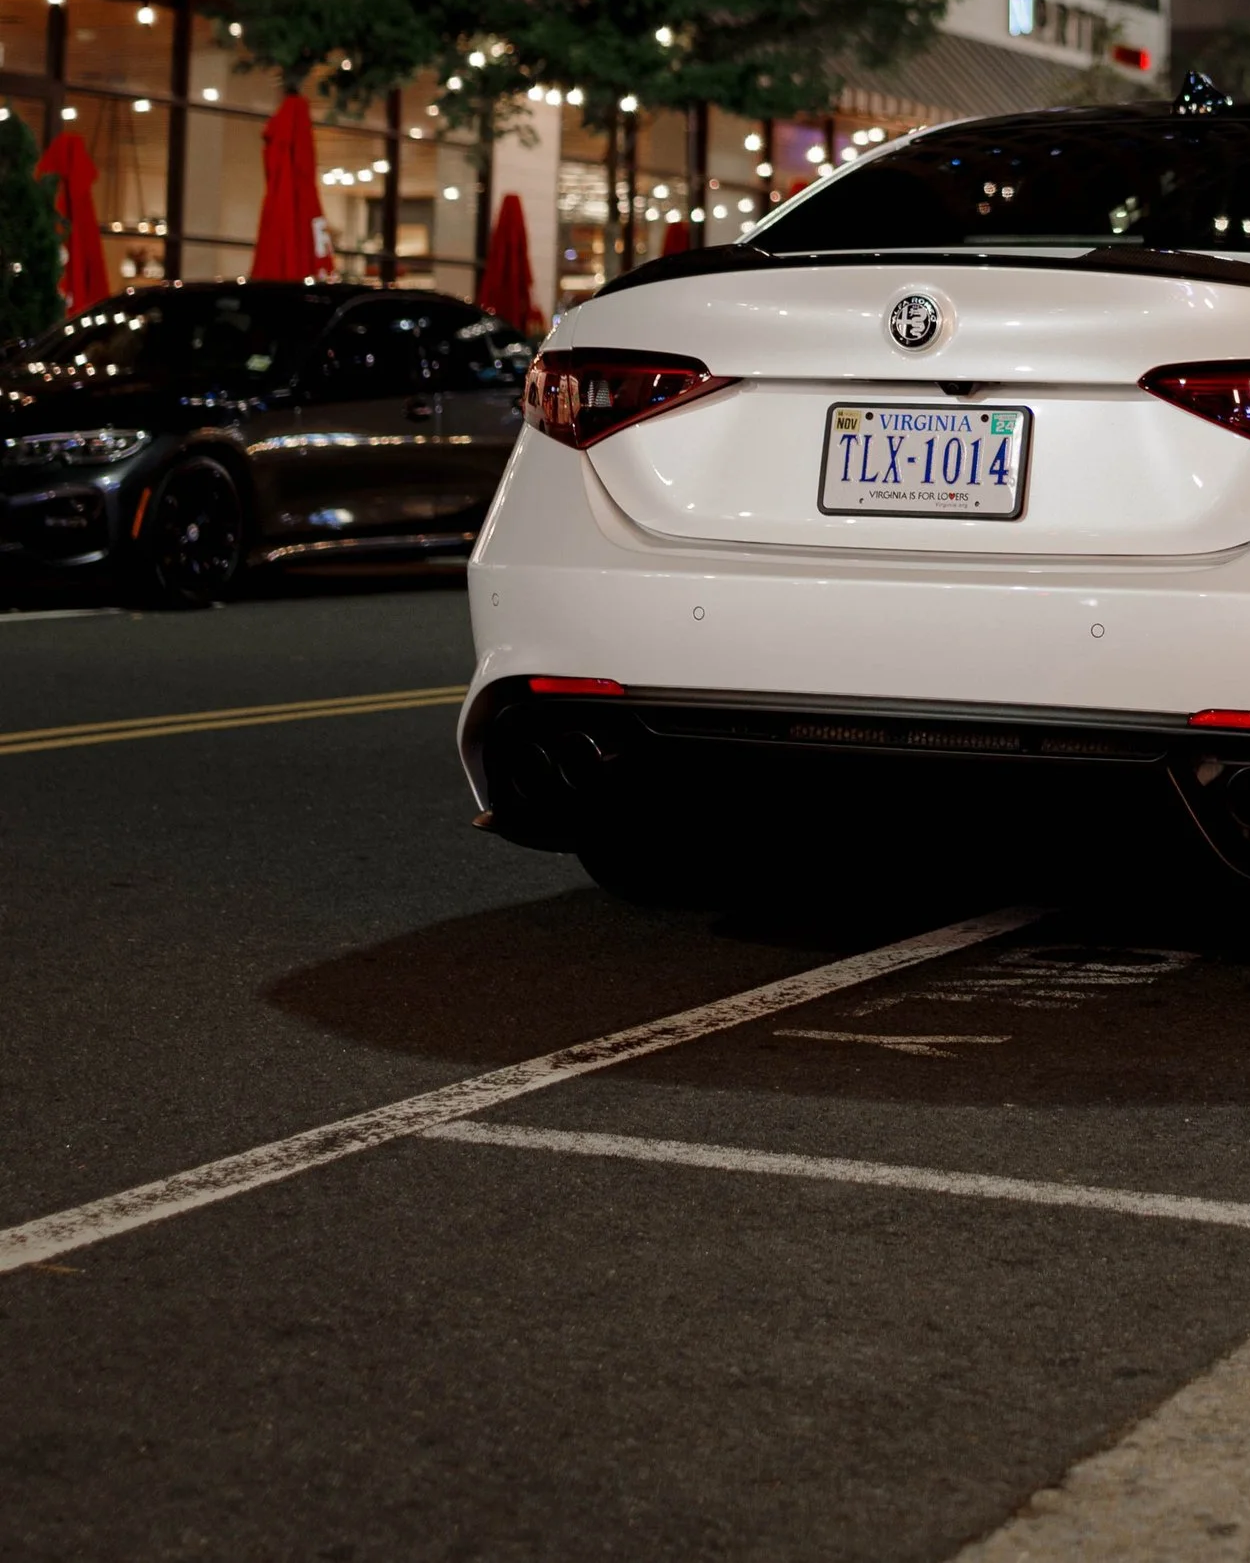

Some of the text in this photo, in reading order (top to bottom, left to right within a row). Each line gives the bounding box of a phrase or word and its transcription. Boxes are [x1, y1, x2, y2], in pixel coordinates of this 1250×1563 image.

[836, 417, 858, 430] NOV
[879, 413, 972, 432] VIRGINIA
[995, 420, 1016, 433] 24
[839, 434, 1011, 485] TLX-1014
[869, 490, 907, 500] VIRGINIA
[909, 491, 916, 500] IS
[917, 491, 936, 501] FOR
